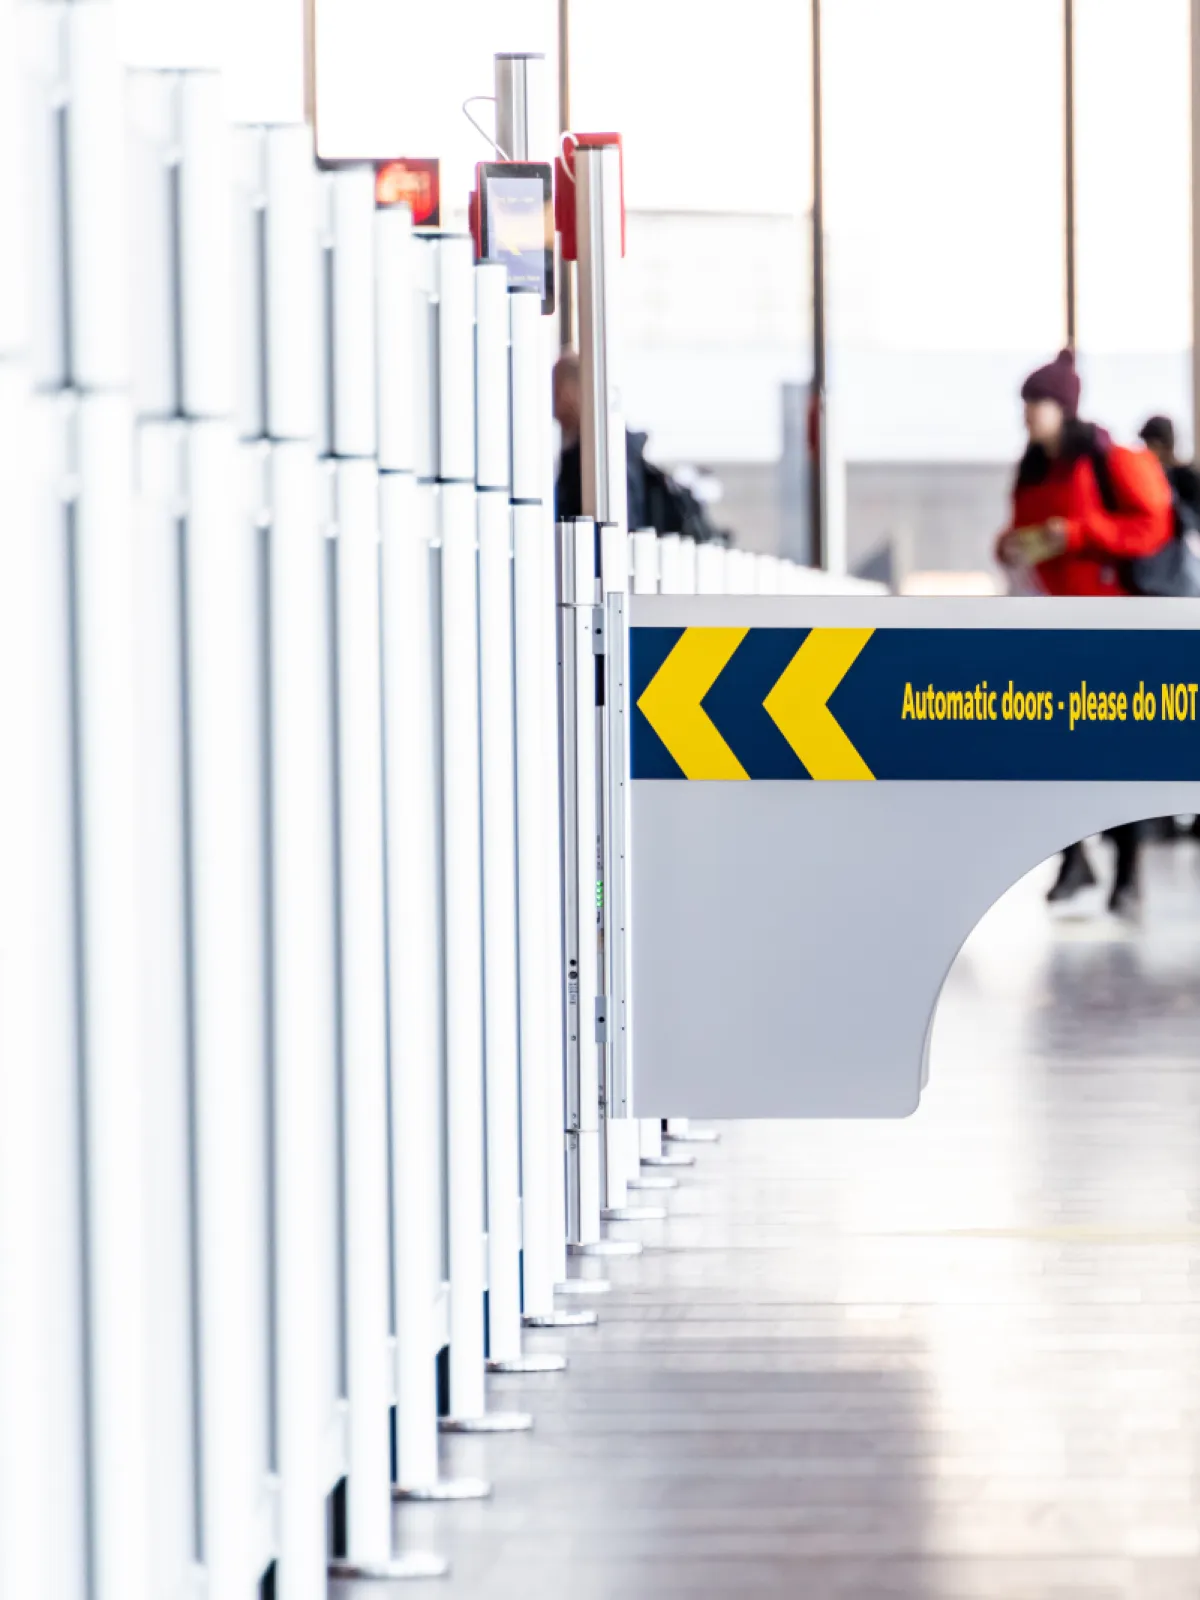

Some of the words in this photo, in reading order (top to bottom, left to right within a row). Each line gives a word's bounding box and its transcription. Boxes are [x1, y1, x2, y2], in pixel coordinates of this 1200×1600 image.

[901, 681, 997, 721] Automatic
[1002, 680, 1053, 721] doors
[1069, 681, 1128, 731] please
[1132, 681, 1156, 721] do
[1162, 683, 1198, 721] NOT
